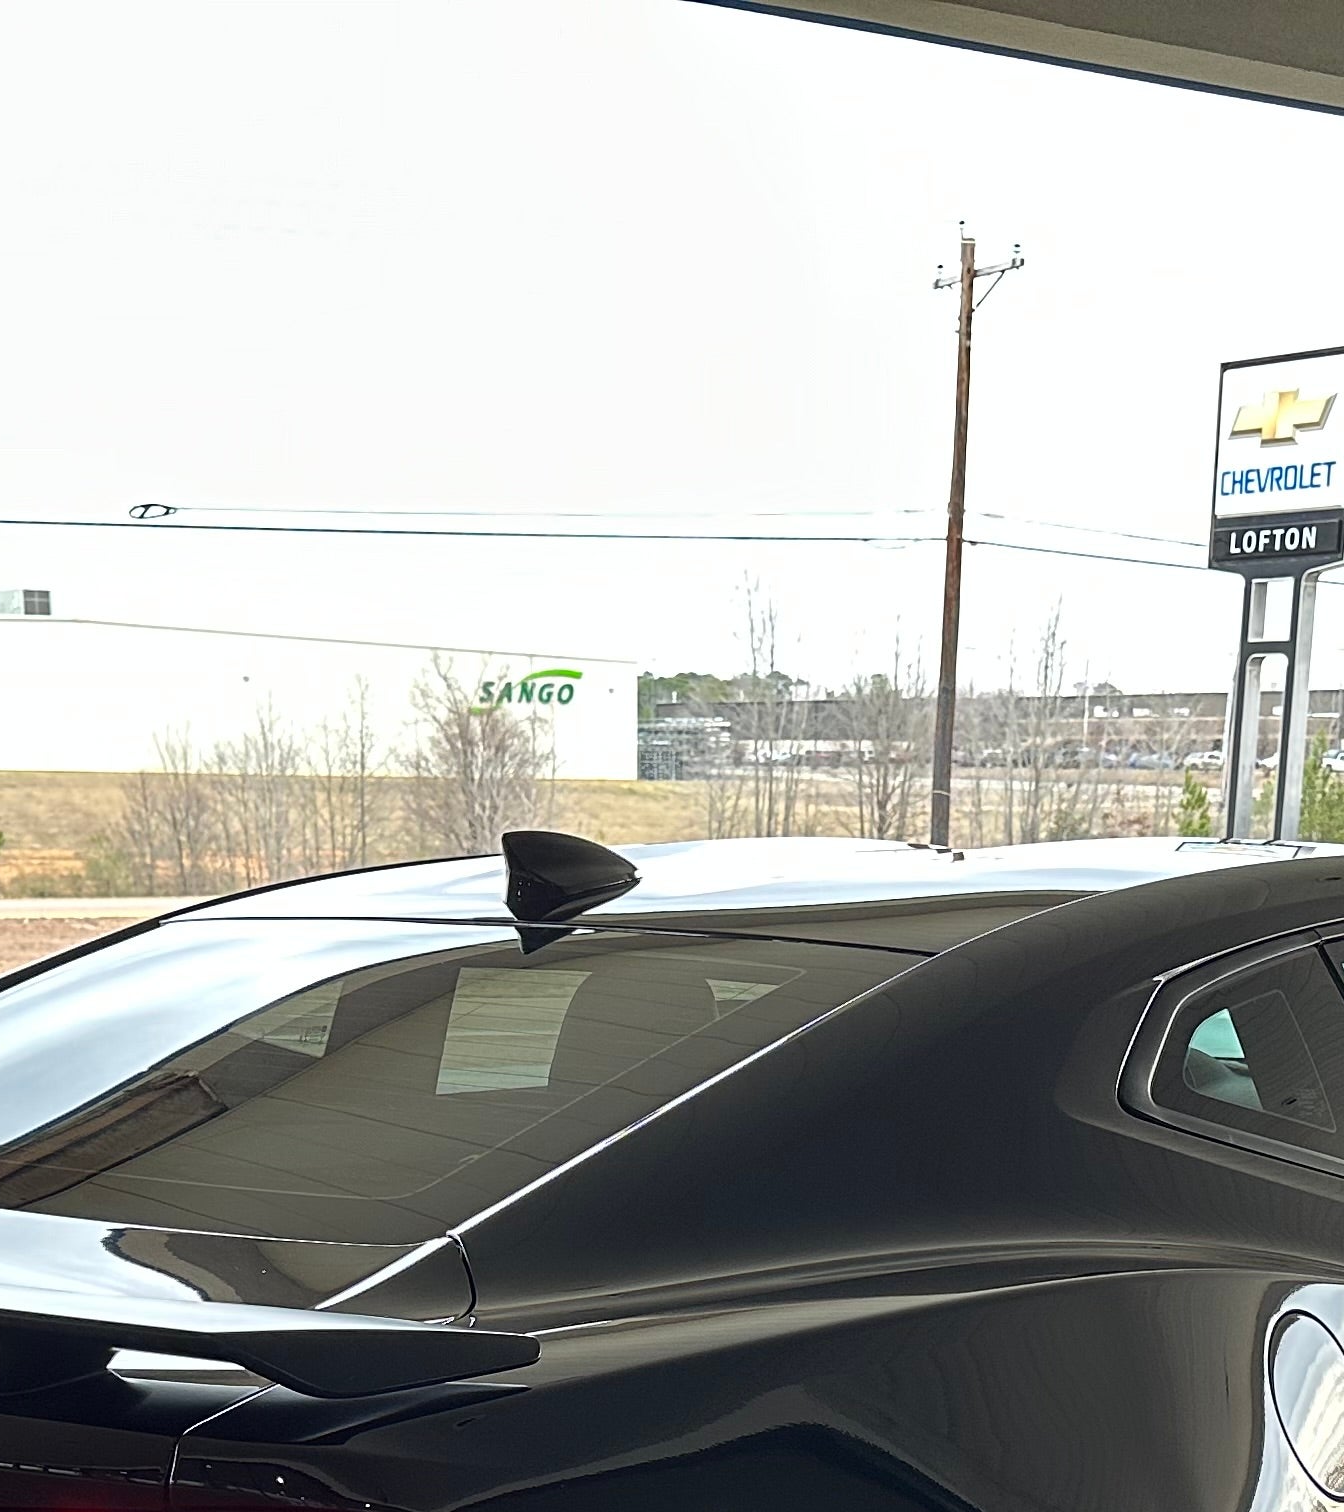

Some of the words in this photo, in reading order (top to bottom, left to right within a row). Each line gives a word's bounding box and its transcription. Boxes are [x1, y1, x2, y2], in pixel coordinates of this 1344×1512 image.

[1220, 461, 1337, 496] CHEVROLET
[1229, 525, 1318, 554] LOFTON
[479, 681, 575, 705] SANGO
